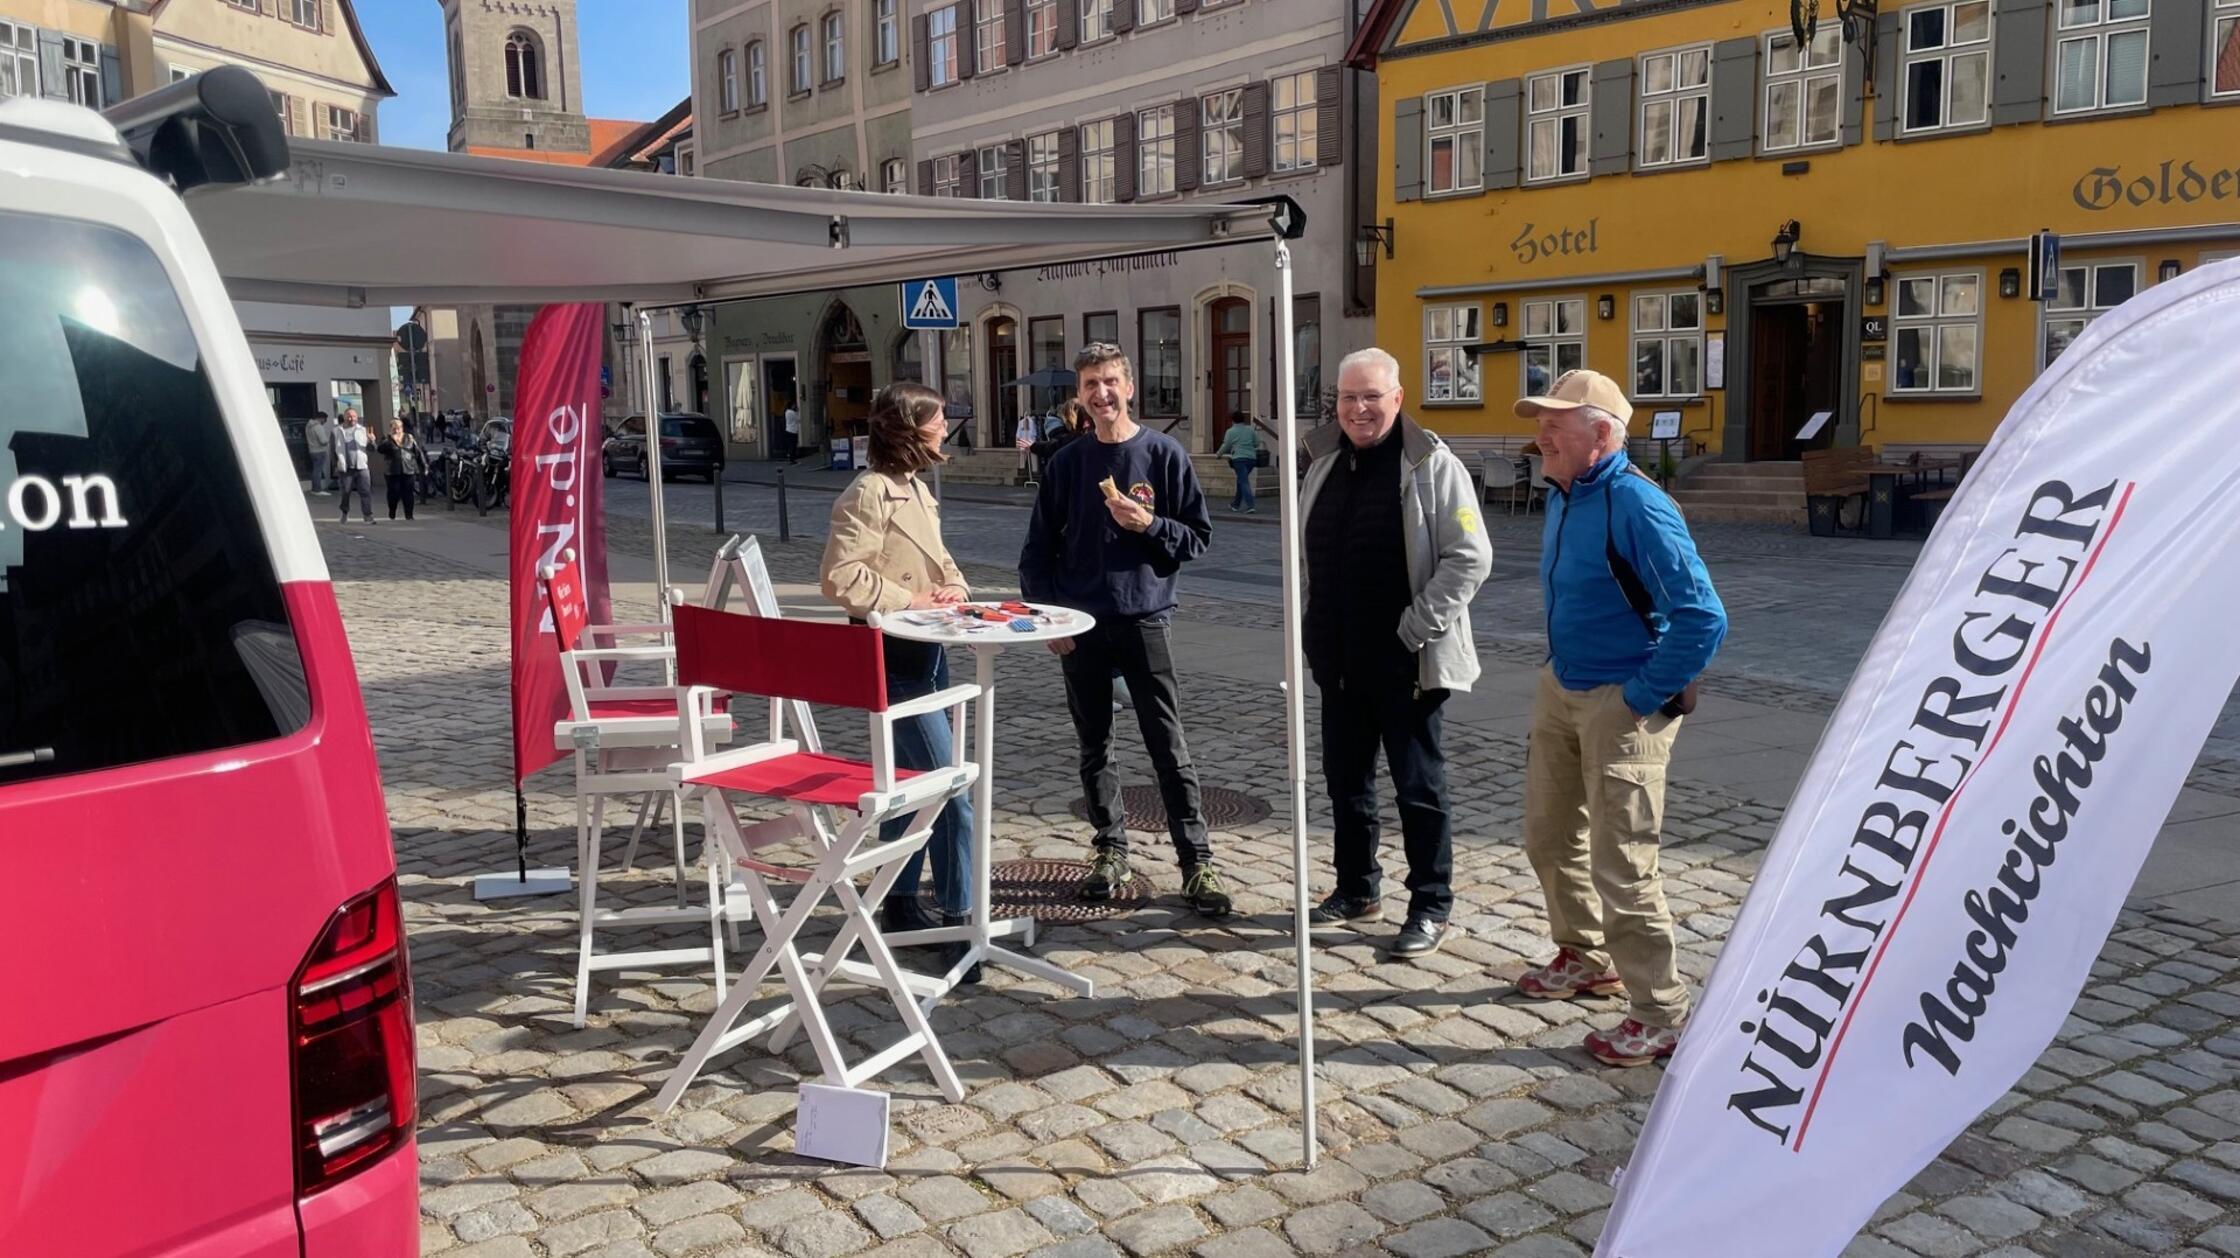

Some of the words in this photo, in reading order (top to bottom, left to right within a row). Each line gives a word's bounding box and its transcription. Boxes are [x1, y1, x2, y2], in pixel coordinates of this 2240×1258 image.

[1510, 216, 1600, 264] Hotel
[2073, 158, 2240, 211] Golde
[1866, 321, 1883, 334] QL
[0, 474, 129, 531] on
[1727, 478, 2121, 1145] NÜRNBERGER
[1903, 636, 2152, 1077] Nachrichten
